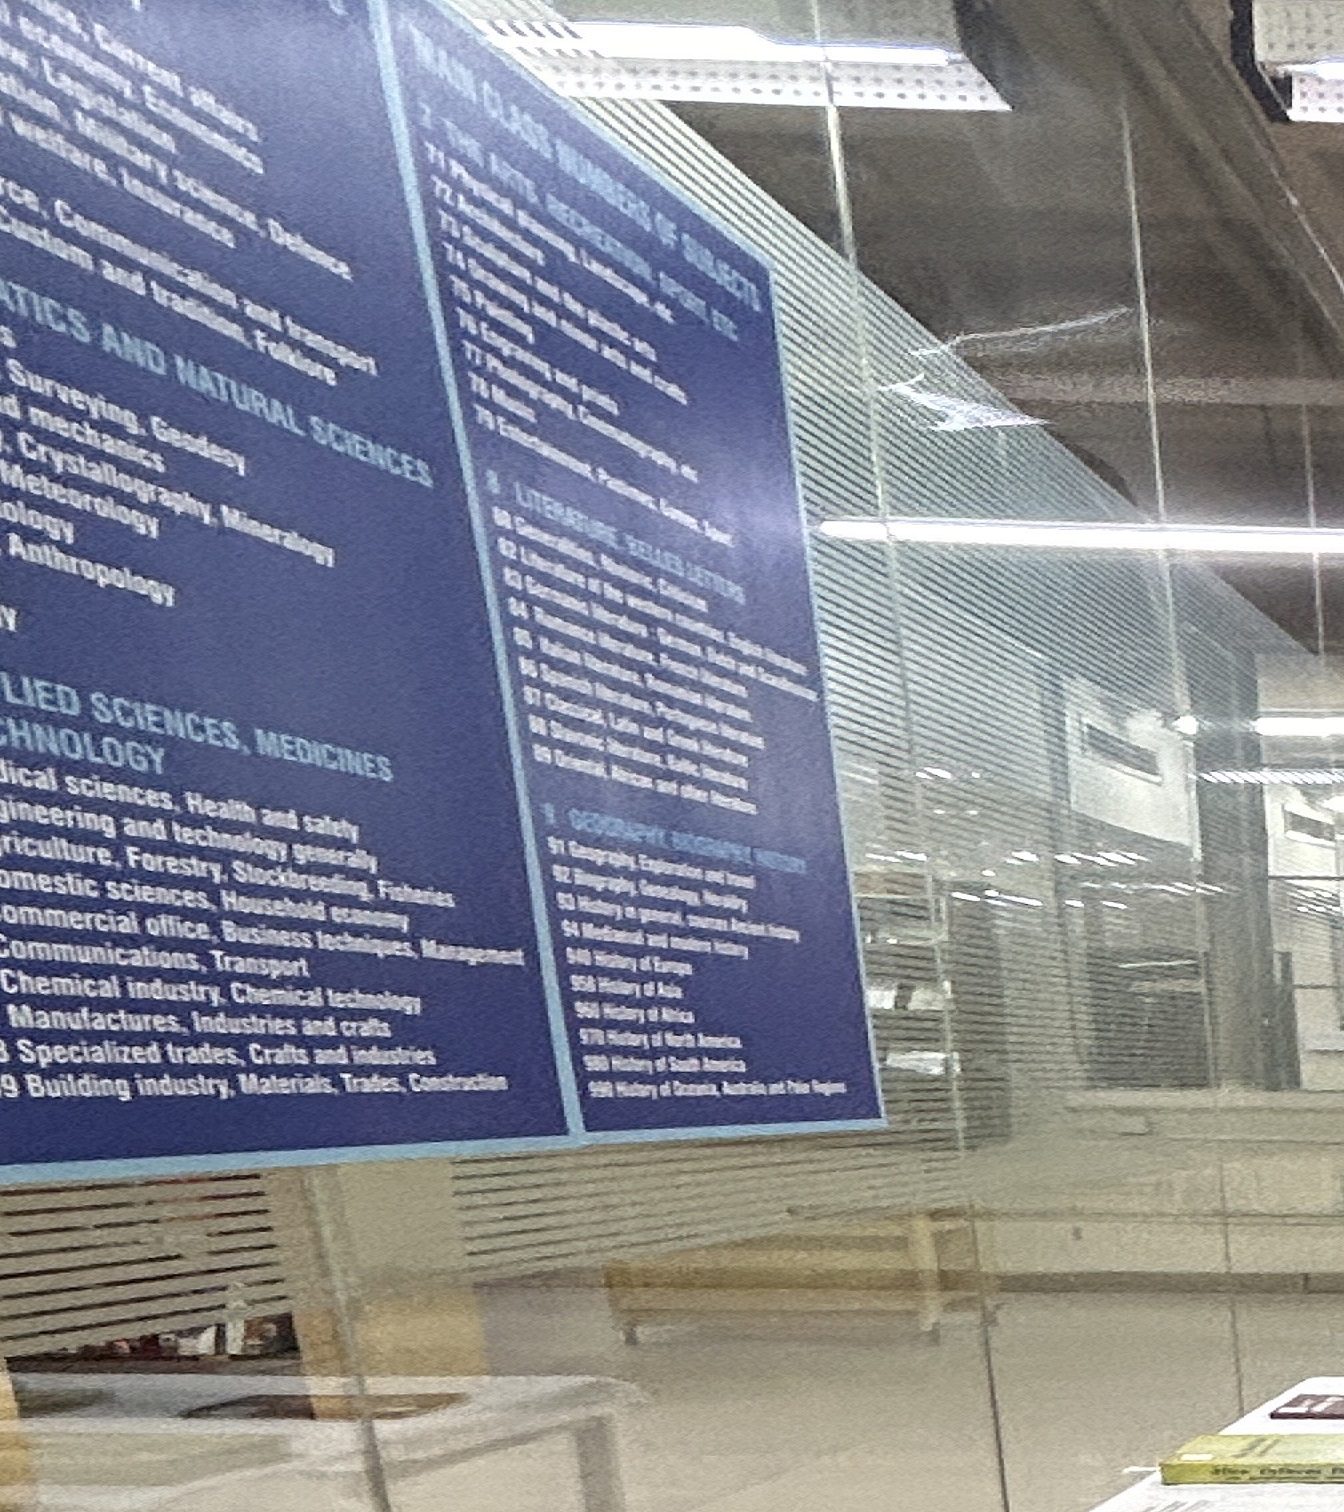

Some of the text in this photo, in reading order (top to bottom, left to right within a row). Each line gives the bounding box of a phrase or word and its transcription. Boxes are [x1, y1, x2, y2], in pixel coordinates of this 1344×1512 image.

[102, 321, 167, 376] AND
[174, 352, 308, 437] NATURAL
[8, 532, 176, 608] Anthropology
[254, 727, 394, 782] MEDICINES
[123, 817, 168, 841] and
[259, 808, 300, 831] and
[1, 968, 122, 999] Chemical
[302, 1016, 338, 1037] and
[16, 1039, 162, 1068] Specialized
[313, 1044, 349, 1065] and
[25, 1073, 132, 1101] Building
